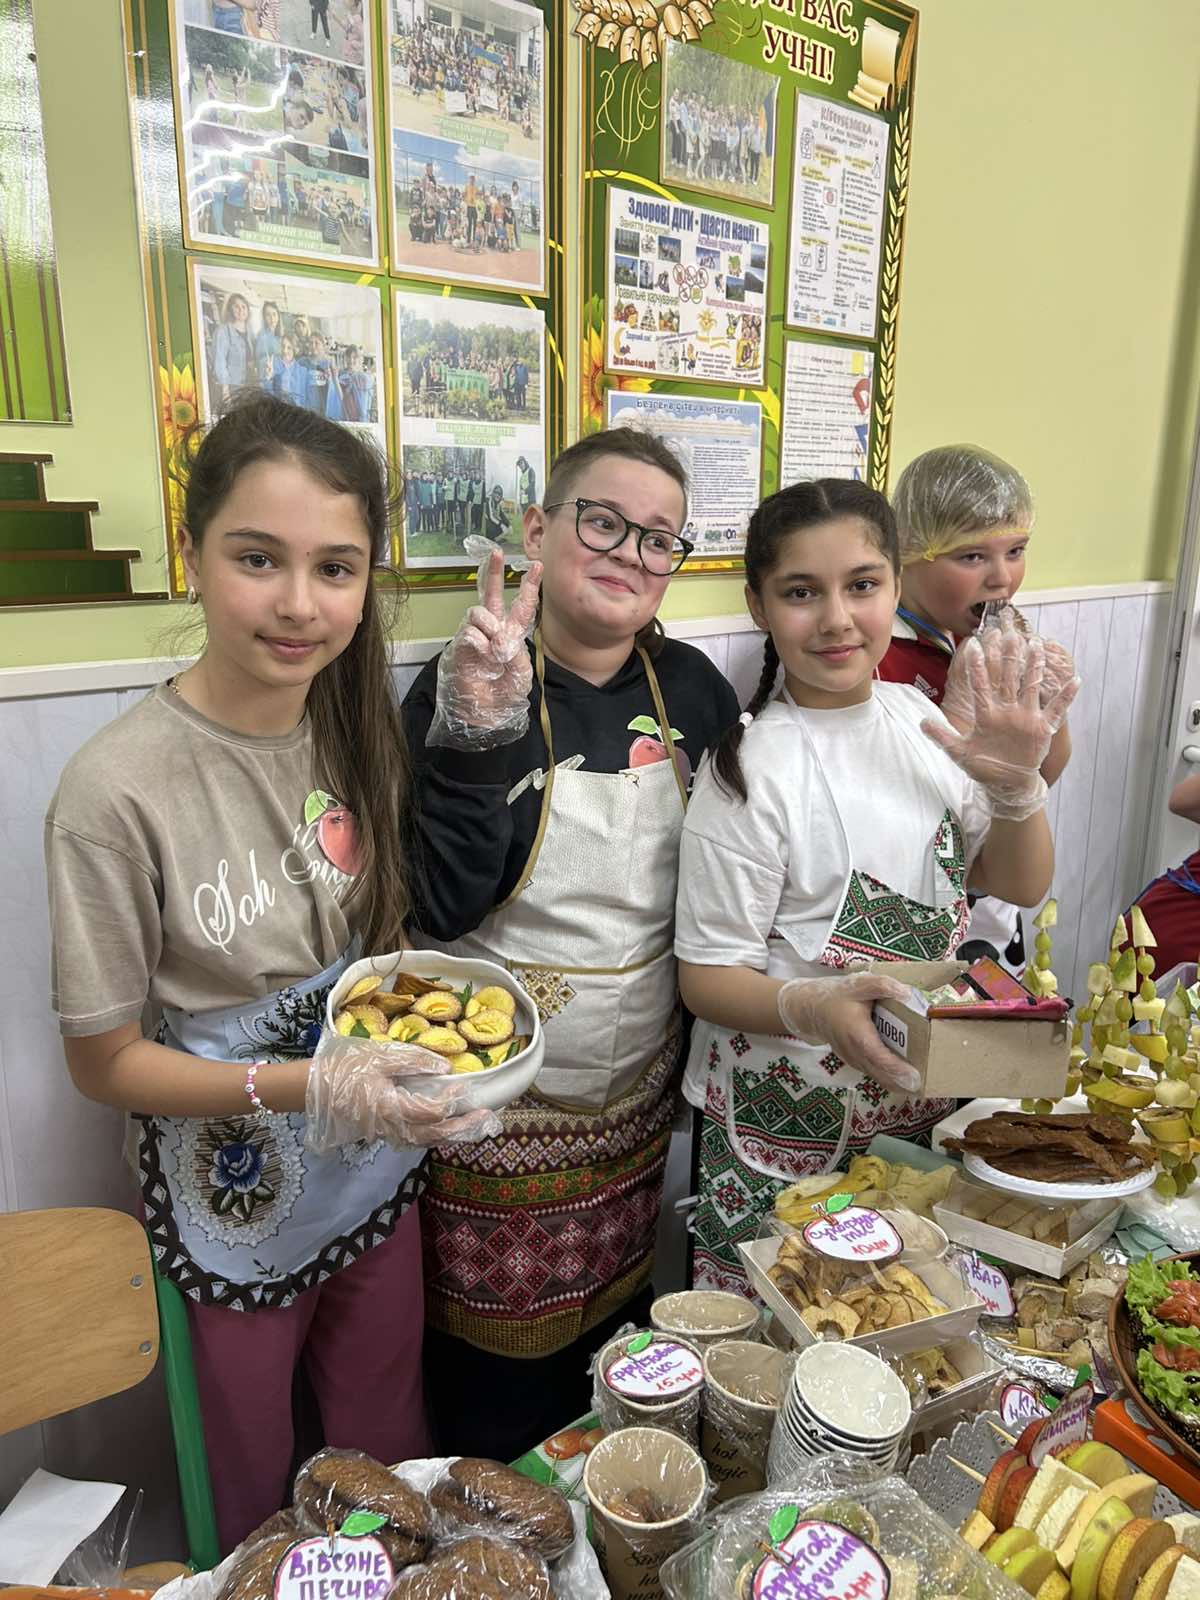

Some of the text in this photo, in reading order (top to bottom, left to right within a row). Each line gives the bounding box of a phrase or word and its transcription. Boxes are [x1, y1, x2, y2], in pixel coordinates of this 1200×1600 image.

[803, 0, 857, 41] ВАС,
[764, 24, 833, 81] УЧНІ!
[628, 197, 670, 226] Здорові
